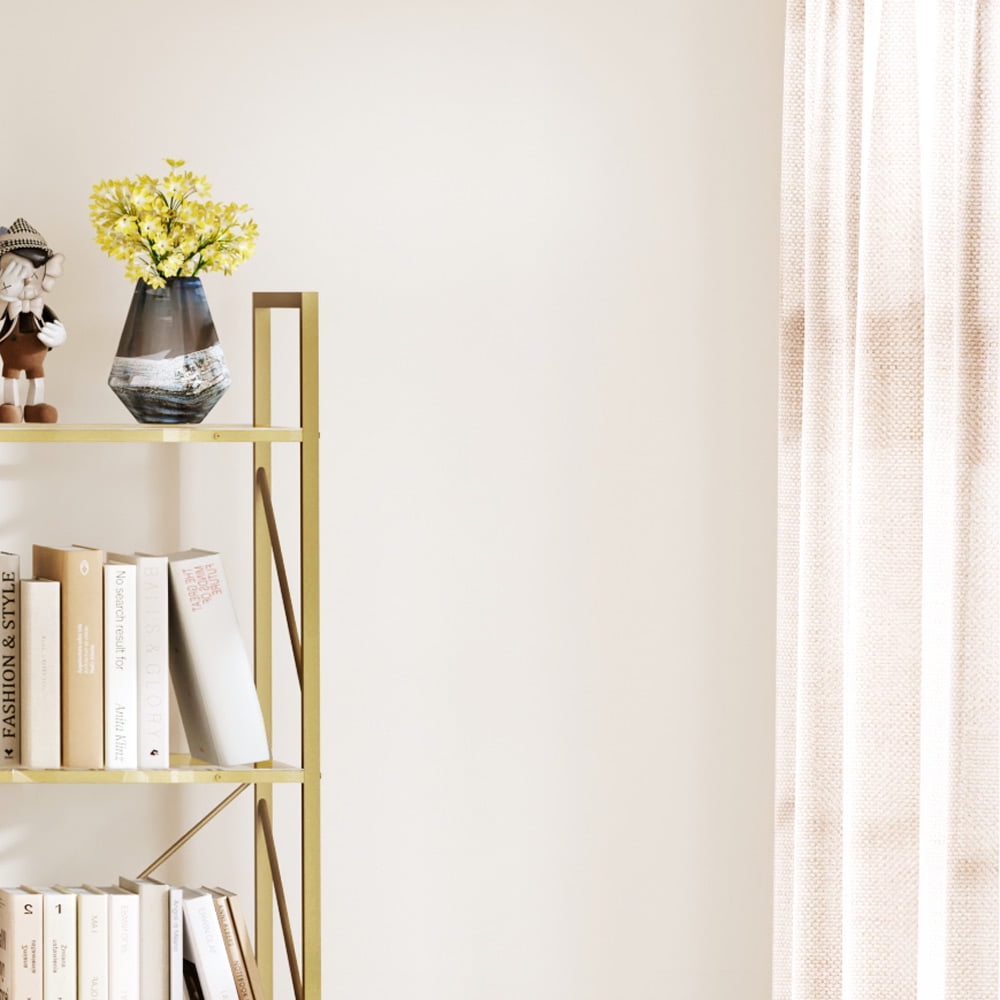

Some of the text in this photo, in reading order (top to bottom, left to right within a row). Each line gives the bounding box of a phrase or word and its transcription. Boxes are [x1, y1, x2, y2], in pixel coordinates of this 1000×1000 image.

[115, 570, 127, 670] No search result for
[2, 571, 16, 739] FASHION & STYLE
[114, 703, 127, 761] Anita Klinz
[56, 903, 62, 914] 1
[234, 959, 249, 997] NOTEBOOK
